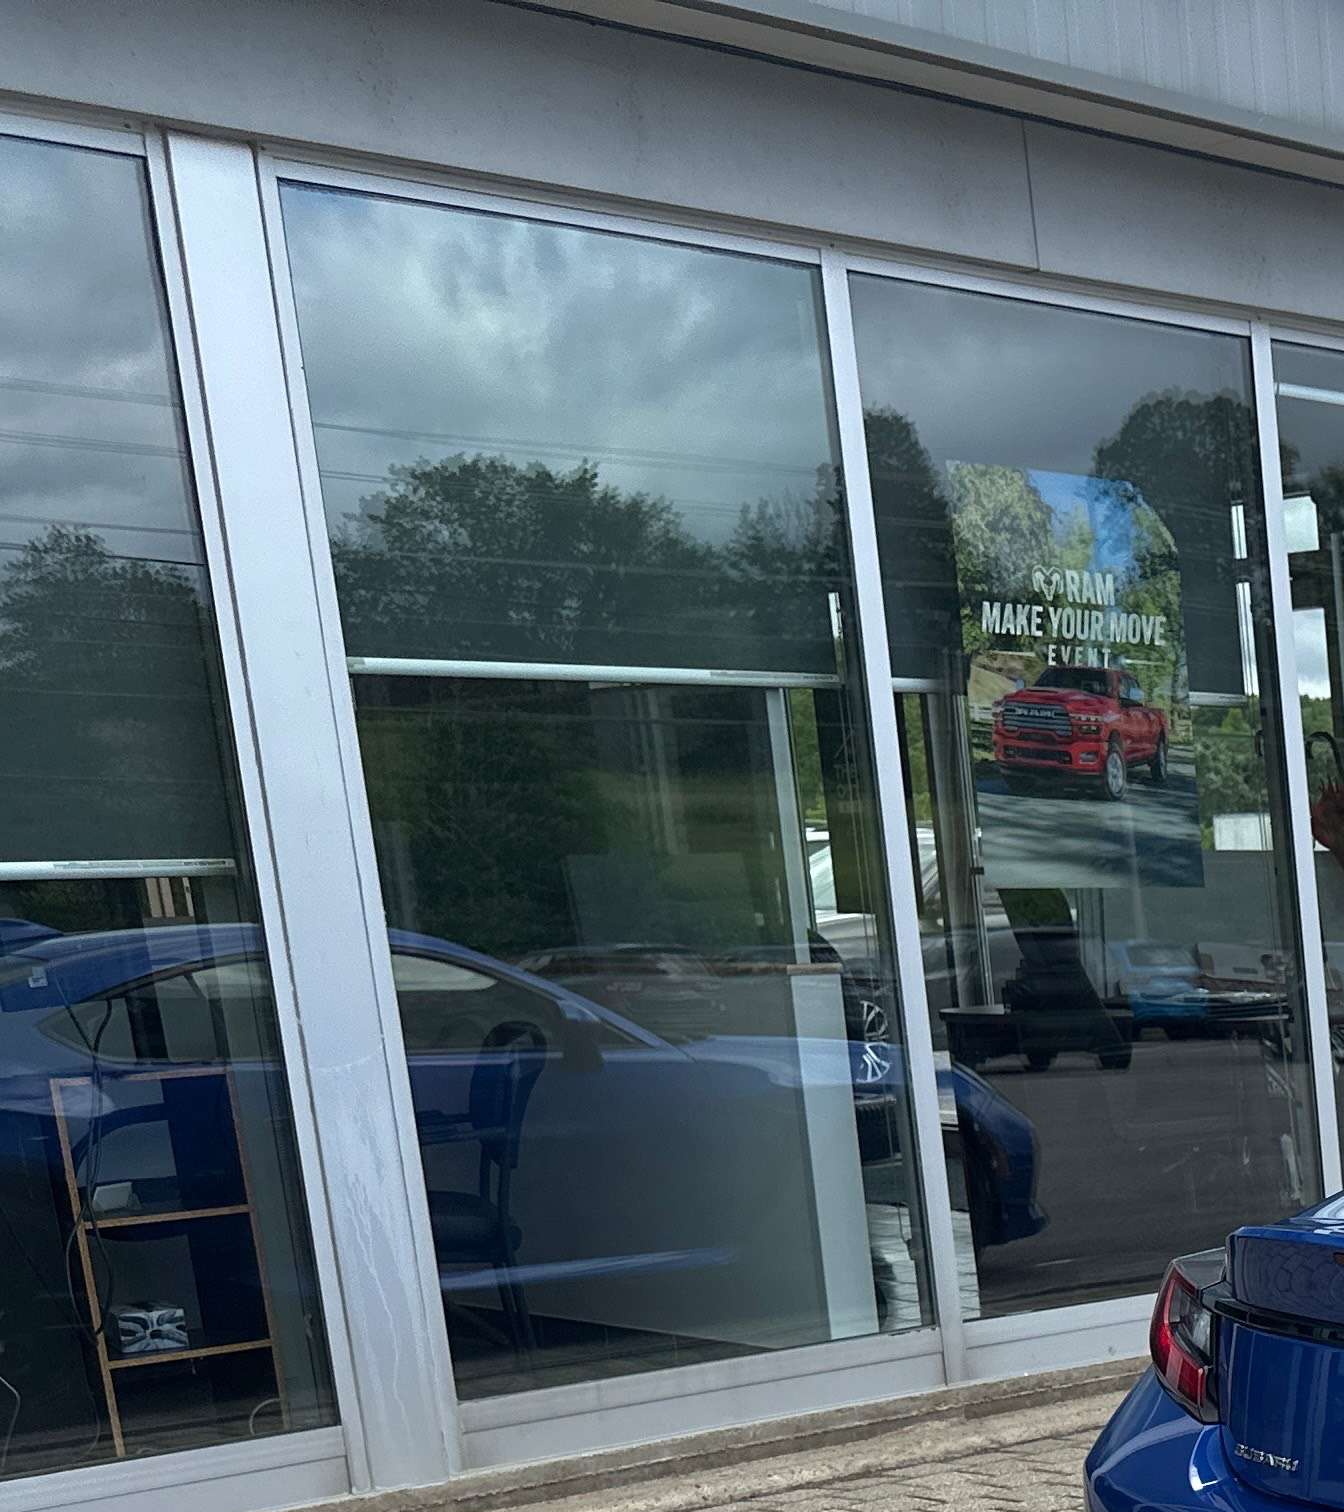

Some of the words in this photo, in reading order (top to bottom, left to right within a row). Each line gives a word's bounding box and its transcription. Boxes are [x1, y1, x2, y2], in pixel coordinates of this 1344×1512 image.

[1065, 569, 1115, 606] RAM
[981, 601, 1043, 637] MAKE
[1049, 606, 1104, 641] YOUR
[1110, 611, 1167, 646] MOVE
[1047, 644, 1112, 669] EVENT
[1234, 1443, 1299, 1472] SUBARU
